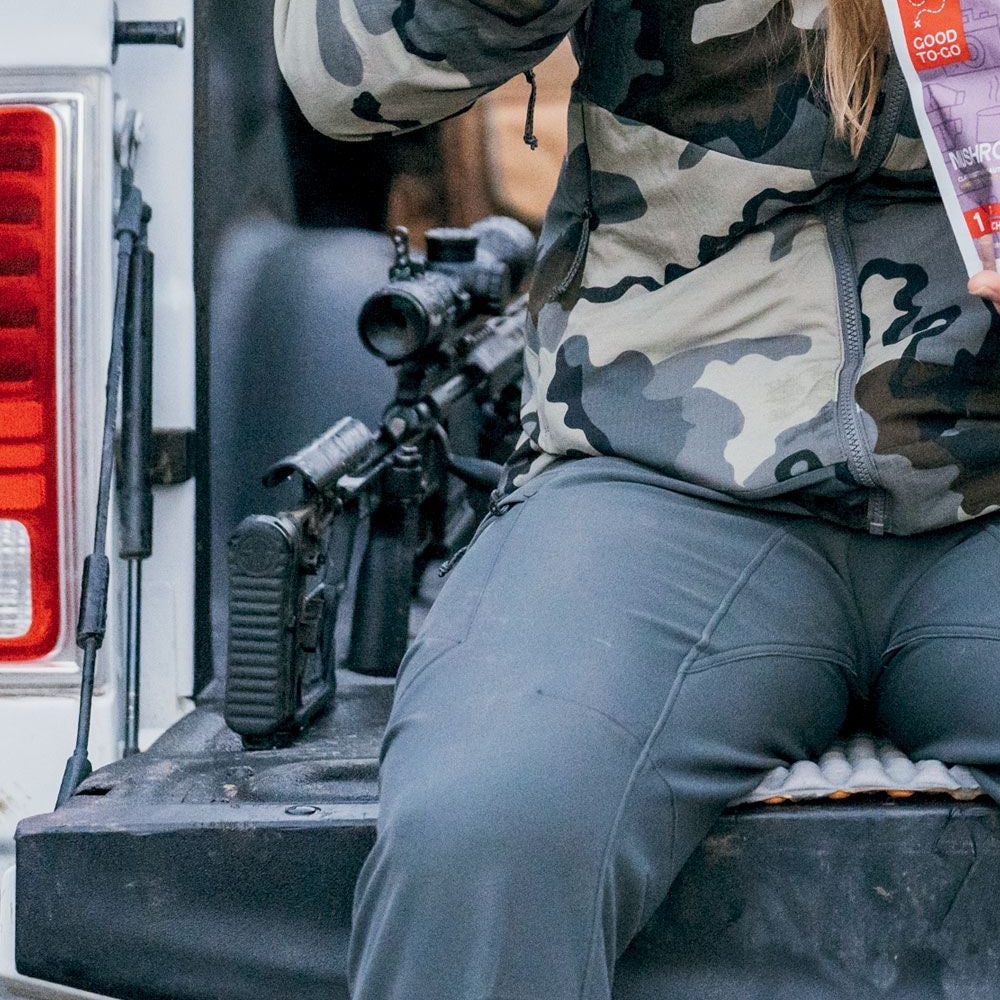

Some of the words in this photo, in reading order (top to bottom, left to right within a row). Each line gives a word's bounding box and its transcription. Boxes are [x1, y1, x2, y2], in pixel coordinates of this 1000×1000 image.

[913, 29, 957, 50] GOOD
[915, 44, 961, 63] TO-GO
[973, 211, 985, 233] 1
